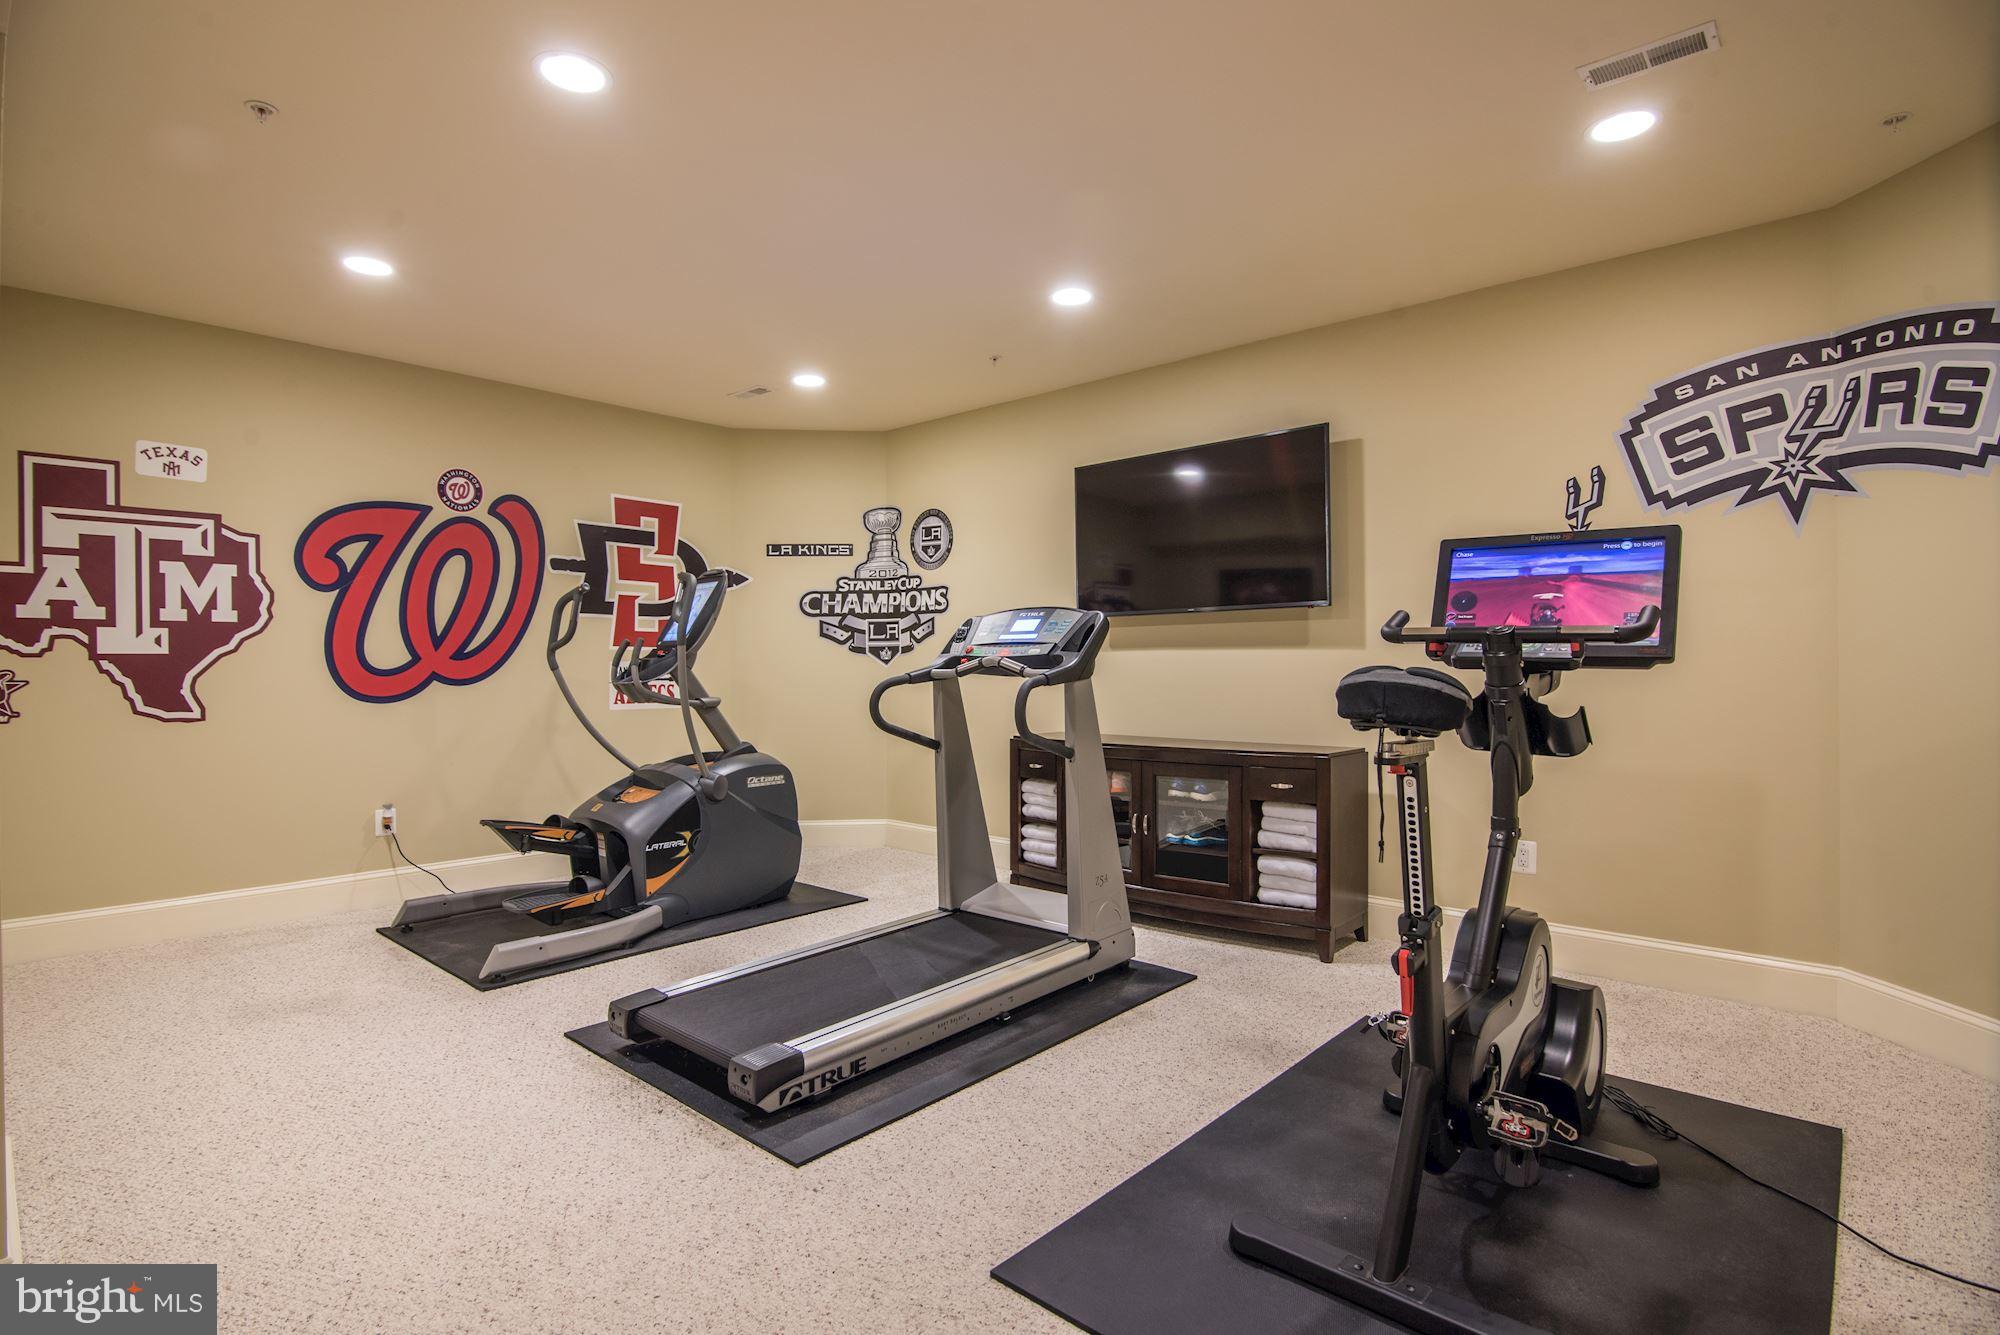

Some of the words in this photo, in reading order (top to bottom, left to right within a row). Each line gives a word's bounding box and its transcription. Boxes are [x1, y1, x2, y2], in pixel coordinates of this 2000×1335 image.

[1674, 362, 1760, 401] SAN
[1785, 318, 1976, 369] ANTONIO
[1657, 364, 1993, 477] SPURS
[140, 447, 203, 467] TEXAS
[440, 470, 480, 489] WASHINGTON
[449, 481, 470, 501] W
[442, 496, 480, 511] NATIONALS
[922, 528, 941, 541] LA
[1530, 534, 1561, 542] Expresso
[768, 545, 793, 556] LA
[798, 545, 851, 556] KINGS
[1642, 540, 1663, 548] begin
[868, 568, 899, 578] 2012
[838, 579, 898, 591] STANLEY
[897, 577, 921, 590] CUP
[294, 494, 546, 704] W
[801, 588, 948, 615] CHAMPIONS
[869, 624, 899, 639] LA
[747, 774, 784, 784] Octane
[802, 1056, 867, 1094] TRUE
